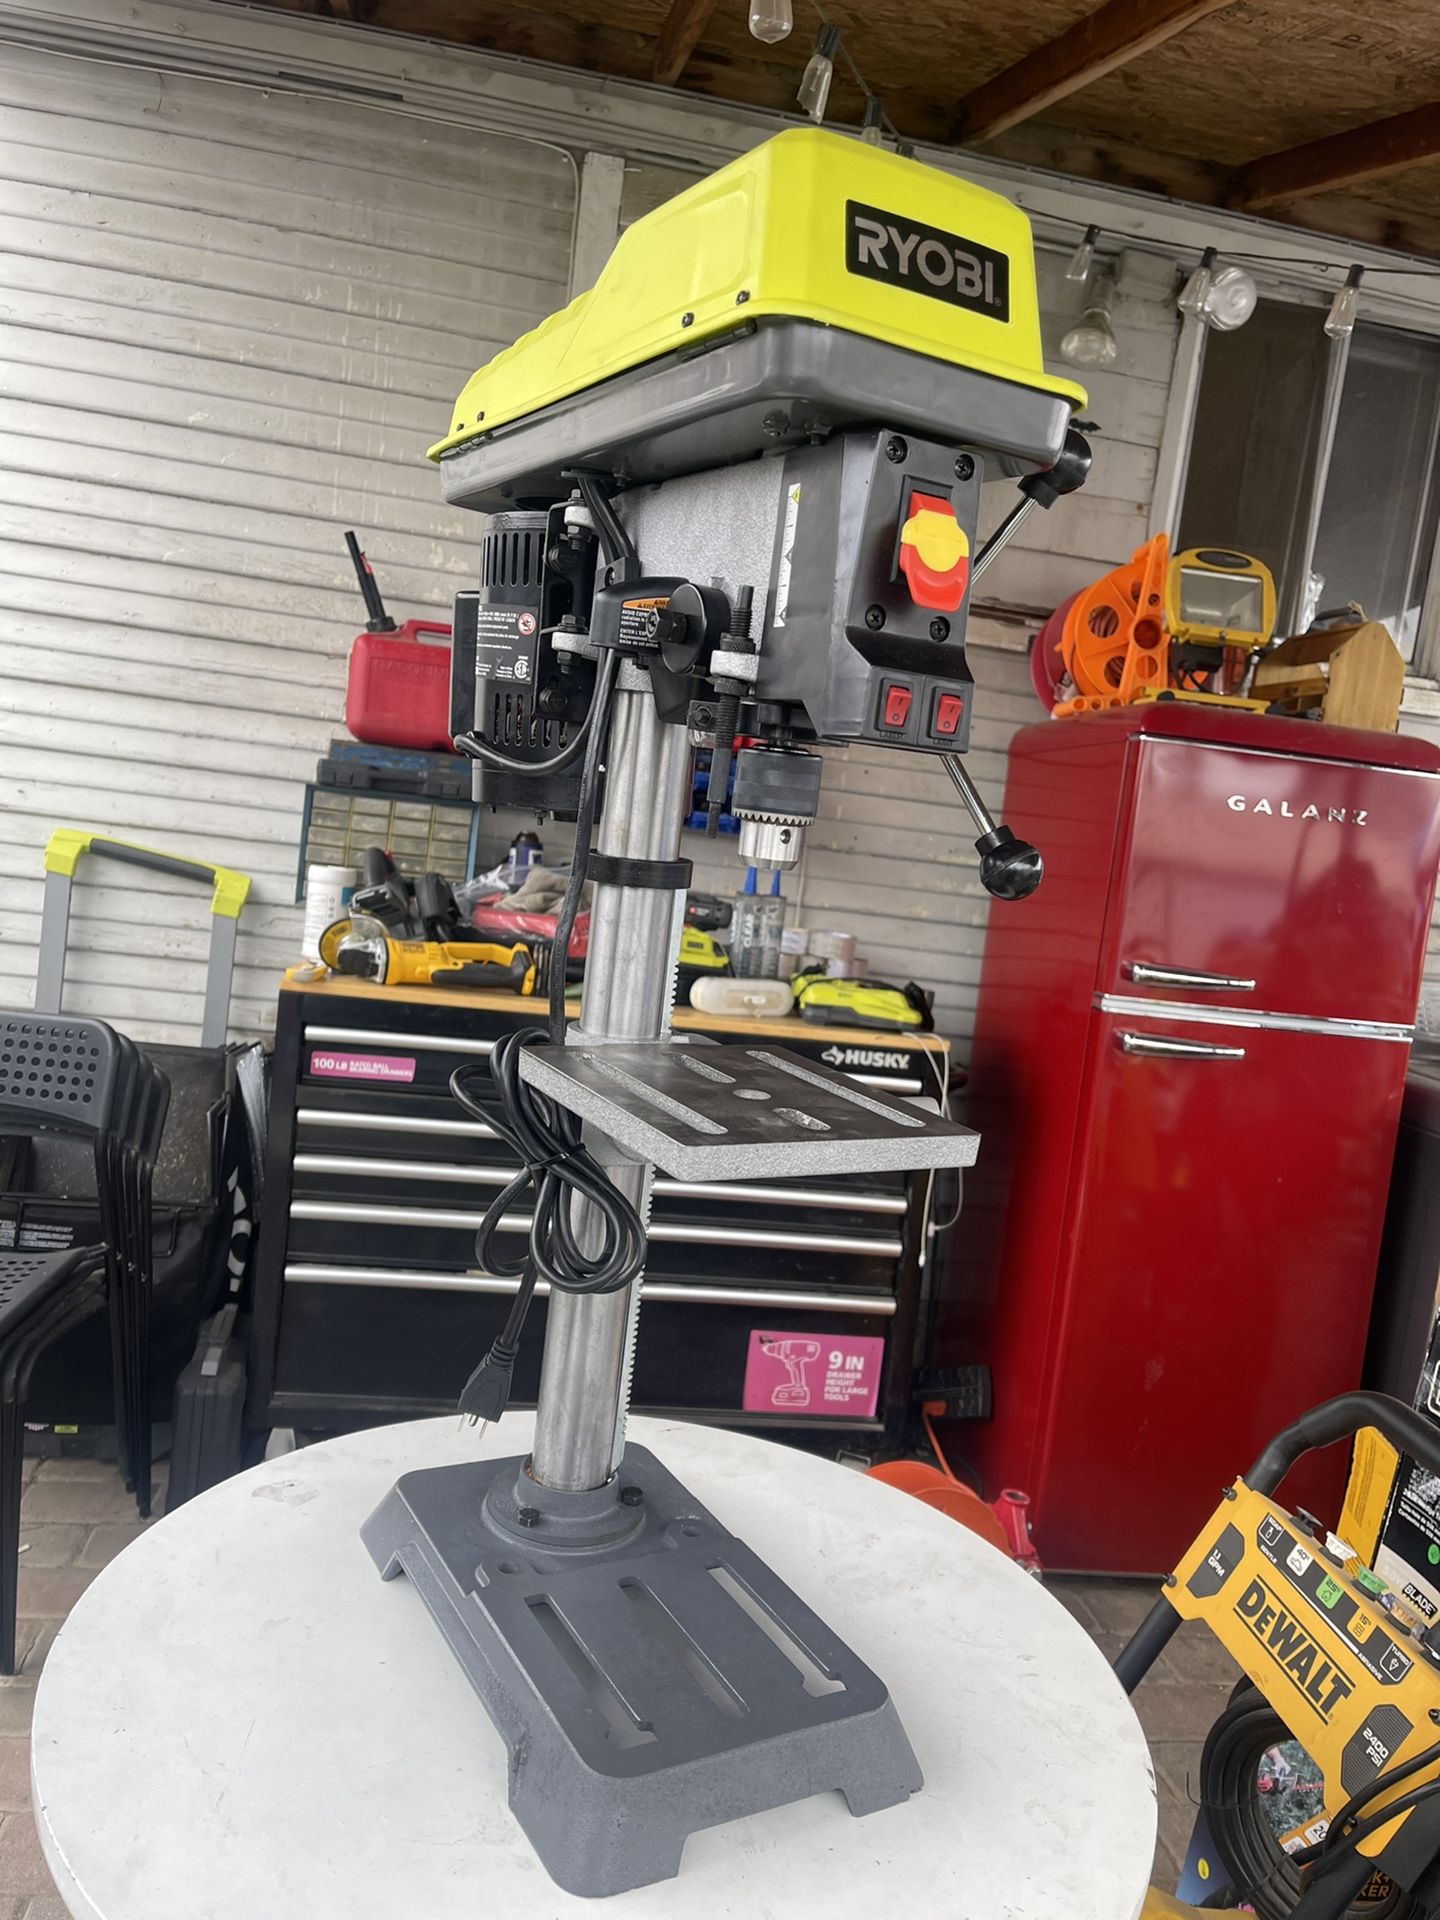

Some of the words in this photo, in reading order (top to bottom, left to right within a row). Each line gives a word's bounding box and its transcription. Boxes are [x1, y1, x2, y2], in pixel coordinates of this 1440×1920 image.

[854, 216, 994, 305] RYOBI
[375, 659, 449, 680] GASOLIN
[1226, 794, 1368, 826] GALANZ
[313, 1057, 334, 1070] 100
[845, 1049, 910, 1069] HUSKY
[828, 1350, 843, 1370] 9
[846, 1356, 864, 1371] IN
[1207, 1557, 1226, 1577] GPM
[1404, 1584, 1433, 1615] BLADE
[1362, 1727, 1389, 1759] 2400
[1365, 1746, 1384, 1768] PSI
